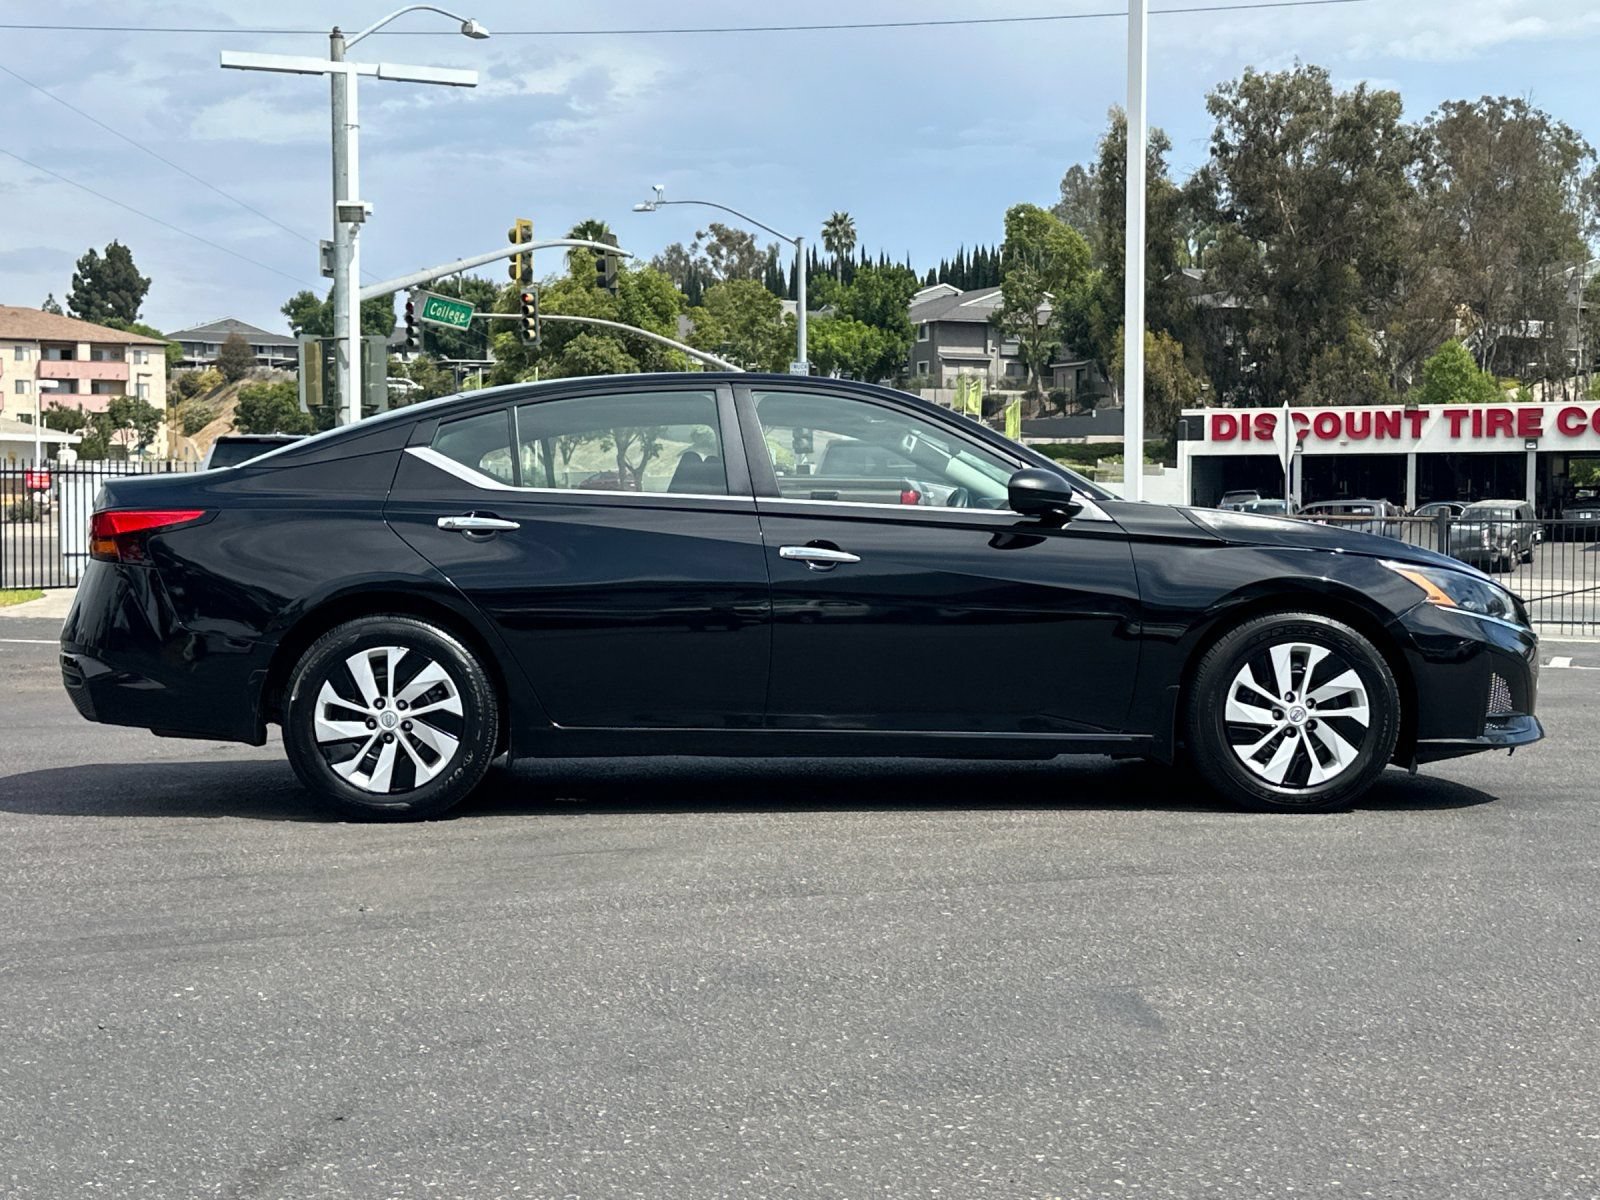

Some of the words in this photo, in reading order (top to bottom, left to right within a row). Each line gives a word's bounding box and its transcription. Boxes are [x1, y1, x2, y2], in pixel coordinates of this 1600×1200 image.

[430, 302, 466, 325] College
[1211, 410, 1430, 441] DISCOUNT
[1443, 408, 1544, 438] TIRE
[1557, 407, 1600, 437] C
